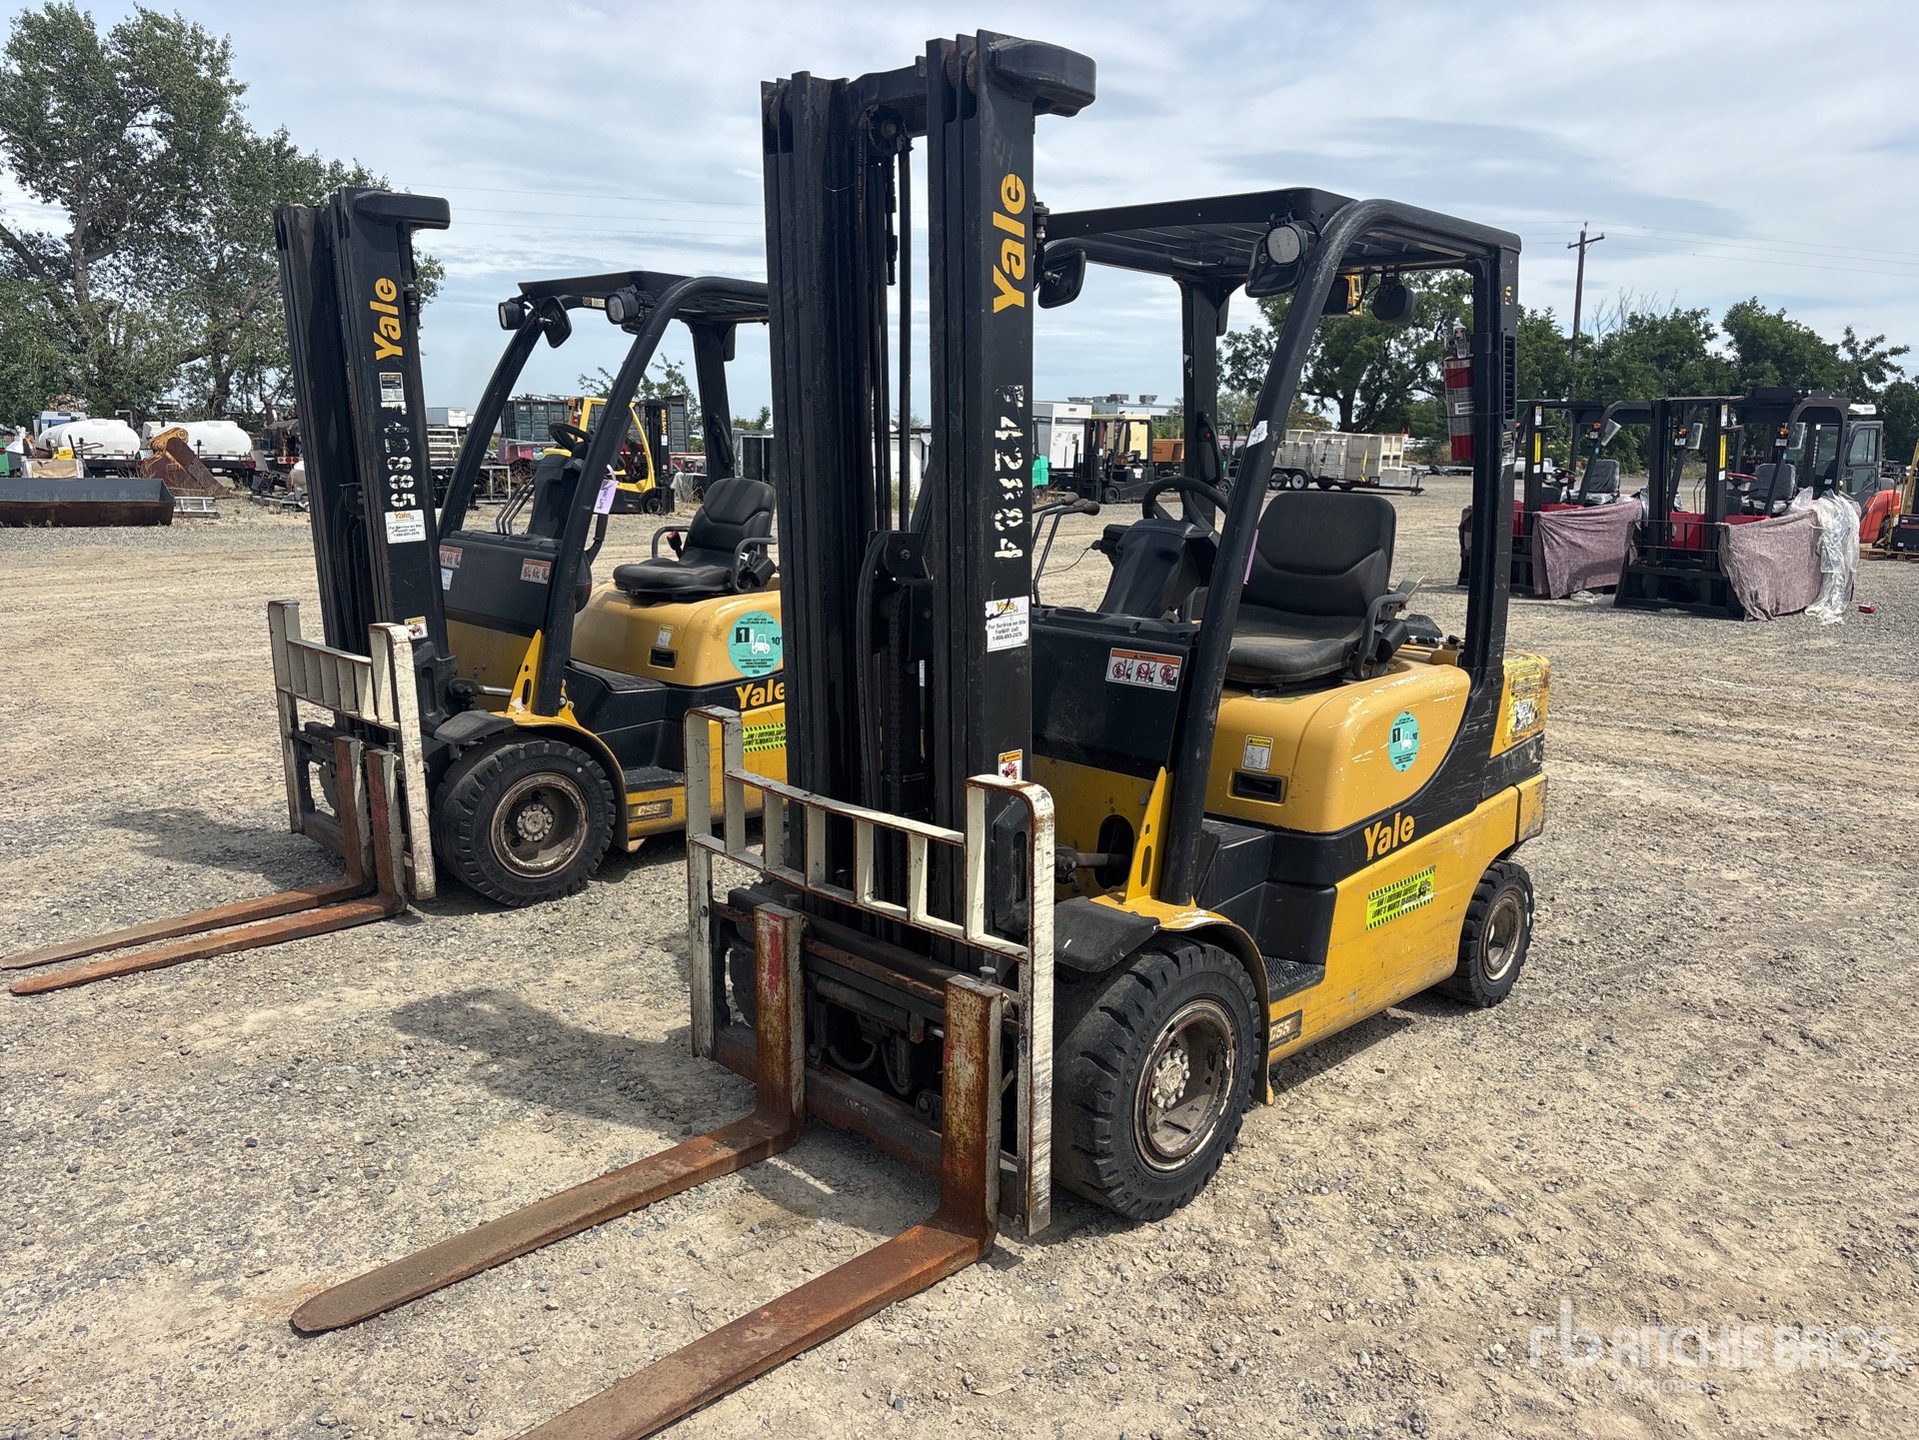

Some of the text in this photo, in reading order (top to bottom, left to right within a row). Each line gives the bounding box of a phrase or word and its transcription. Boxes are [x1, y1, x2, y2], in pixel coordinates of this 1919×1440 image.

[992, 173, 1027, 314] Yale
[369, 277, 404, 361] Yale
[740, 629, 745, 642] 1
[1364, 812, 1415, 861] Yale
